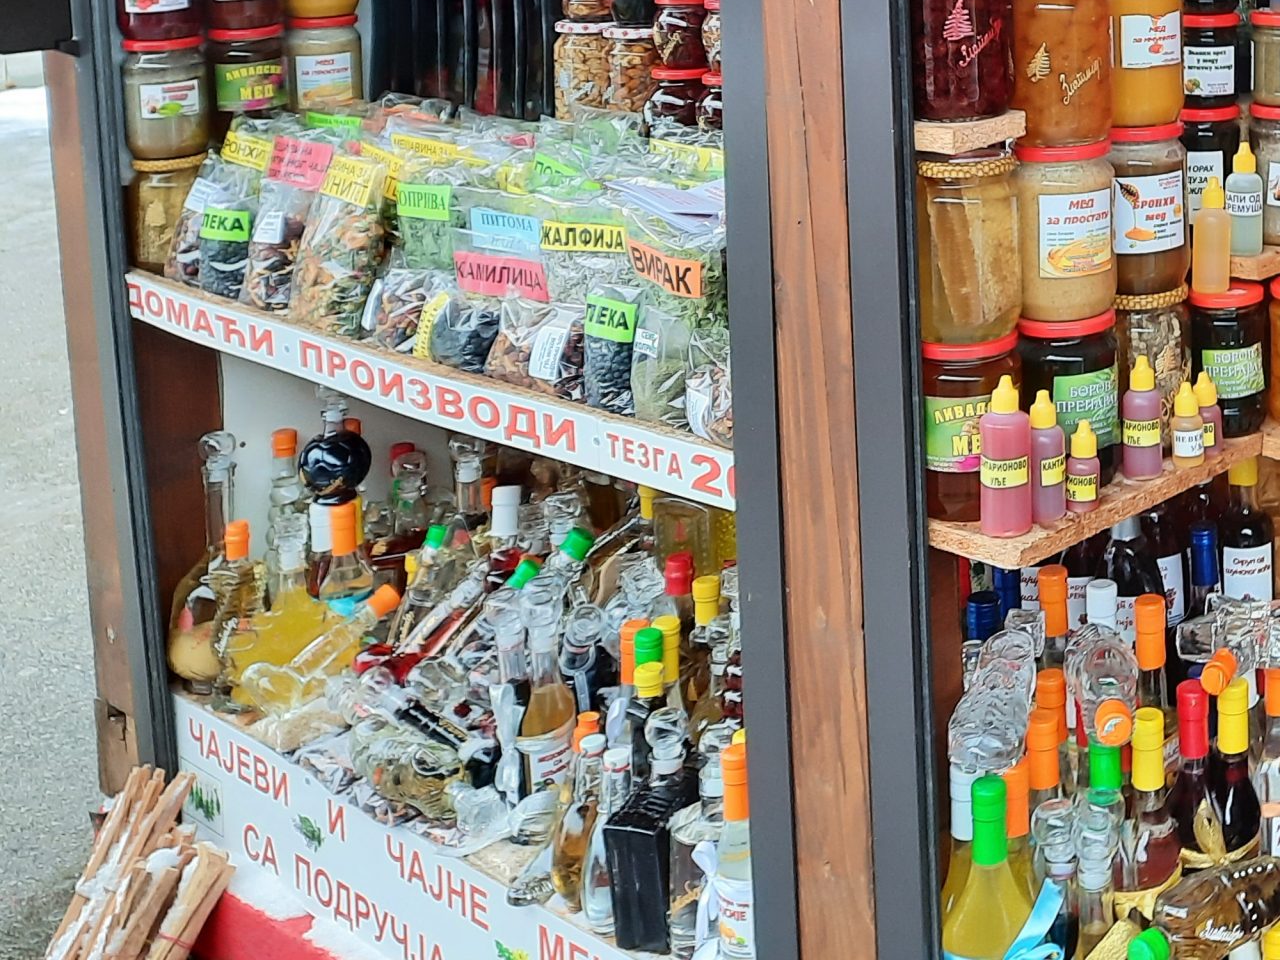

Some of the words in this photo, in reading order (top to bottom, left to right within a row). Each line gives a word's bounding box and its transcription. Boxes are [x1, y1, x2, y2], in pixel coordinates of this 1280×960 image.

[239, 84, 274, 100] МЕД
[1194, 164, 1214, 173] ОРАХ
[399, 189, 446, 211] ОПРИВА
[1068, 197, 1095, 211] МЕД
[1132, 195, 1176, 210] БРОНХИ
[1249, 193, 1261, 203] ОД
[480, 212, 533, 232] ПИТОМА
[541, 225, 625, 251] ЖАЛФИЈА
[455, 259, 543, 291] КАМИЛИЦА
[630, 245, 693, 295] ВИРАК
[126, 282, 275, 357] ДОМАЋИ
[299, 339, 577, 453] ПРОИЗВОДИ
[606, 432, 684, 481] ТЕЗГА
[1126, 434, 1142, 445] УЉЕ
[990, 476, 1007, 487] УЉЕ
[188, 716, 290, 808] ЧАЈЕВИ
[326, 798, 346, 843] И
[385, 833, 490, 932] ЧАЈНЕ
[243, 823, 280, 876] СА
